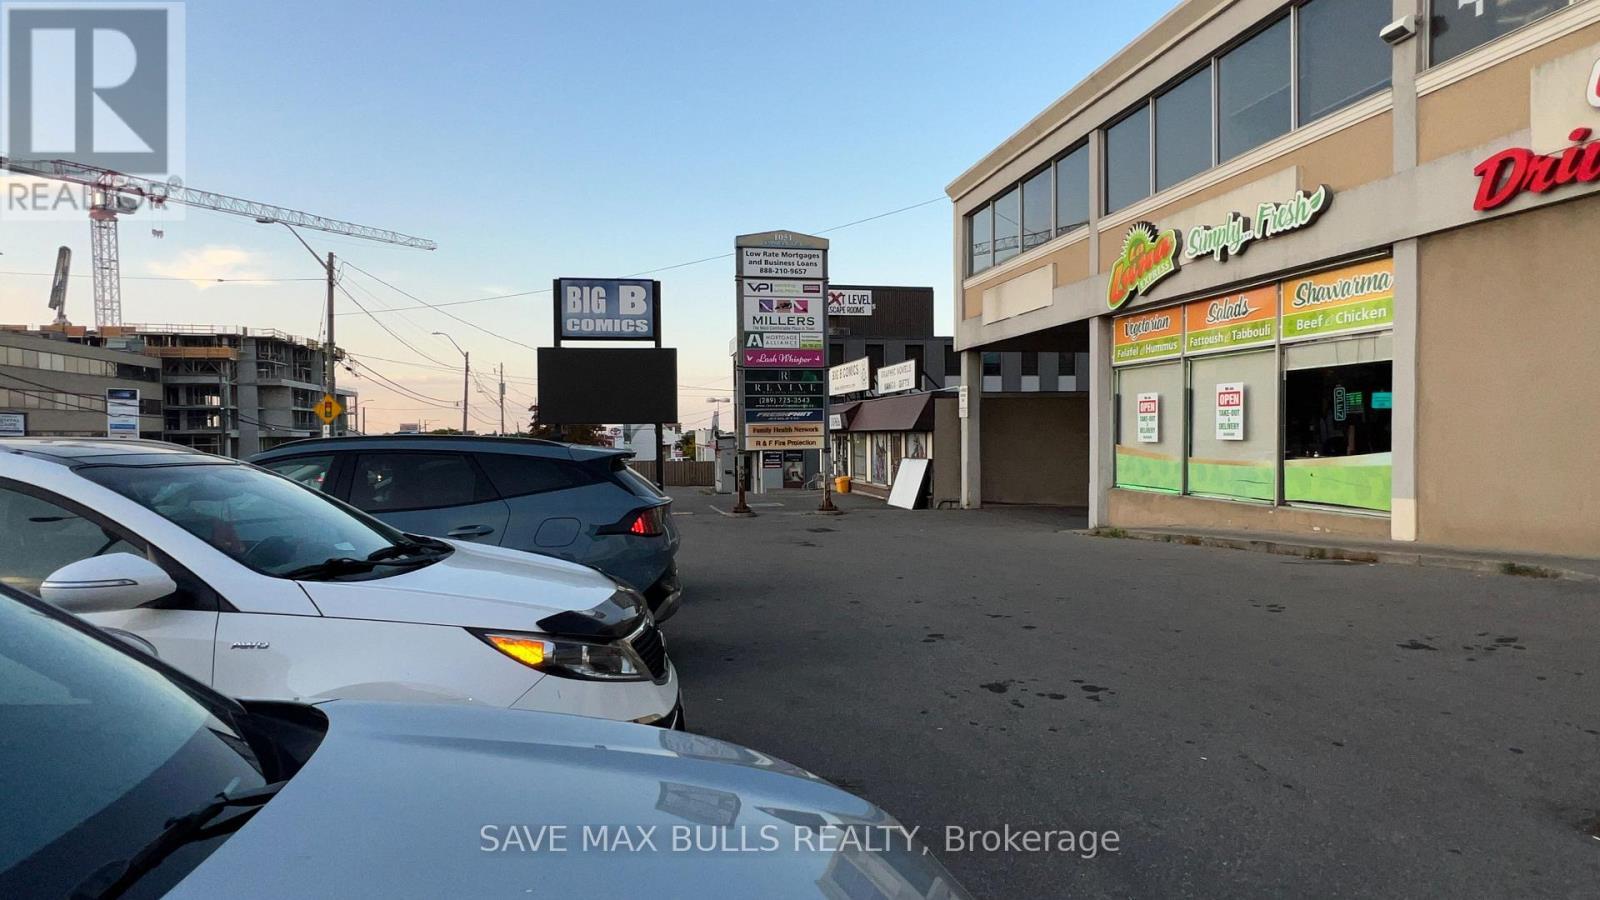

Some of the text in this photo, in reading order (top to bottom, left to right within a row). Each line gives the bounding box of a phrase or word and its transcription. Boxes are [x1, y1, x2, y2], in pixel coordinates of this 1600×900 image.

[1255, 191, 1311, 238] Fresh
[781, 250, 820, 260] Mortgages
[747, 282, 773, 293] VPI
[1292, 272, 1393, 308] Shawarma
[567, 285, 647, 315] BIG B
[828, 291, 871, 305] XT LEVEL
[847, 306, 865, 314] ROOMS
[1206, 295, 1250, 324] Salads
[566, 318, 649, 332] COMICS
[752, 316, 815, 326] MILLERS
[1296, 307, 1387, 330] Beef Chicken
[1189, 324, 1271, 347] Fattoush Tabbouli
[1145, 341, 1177, 354] Hummus
[756, 354, 812, 365] Lash Whisper
[1219, 393, 1240, 405] OPEN
[1140, 402, 1155, 412] OPEN
